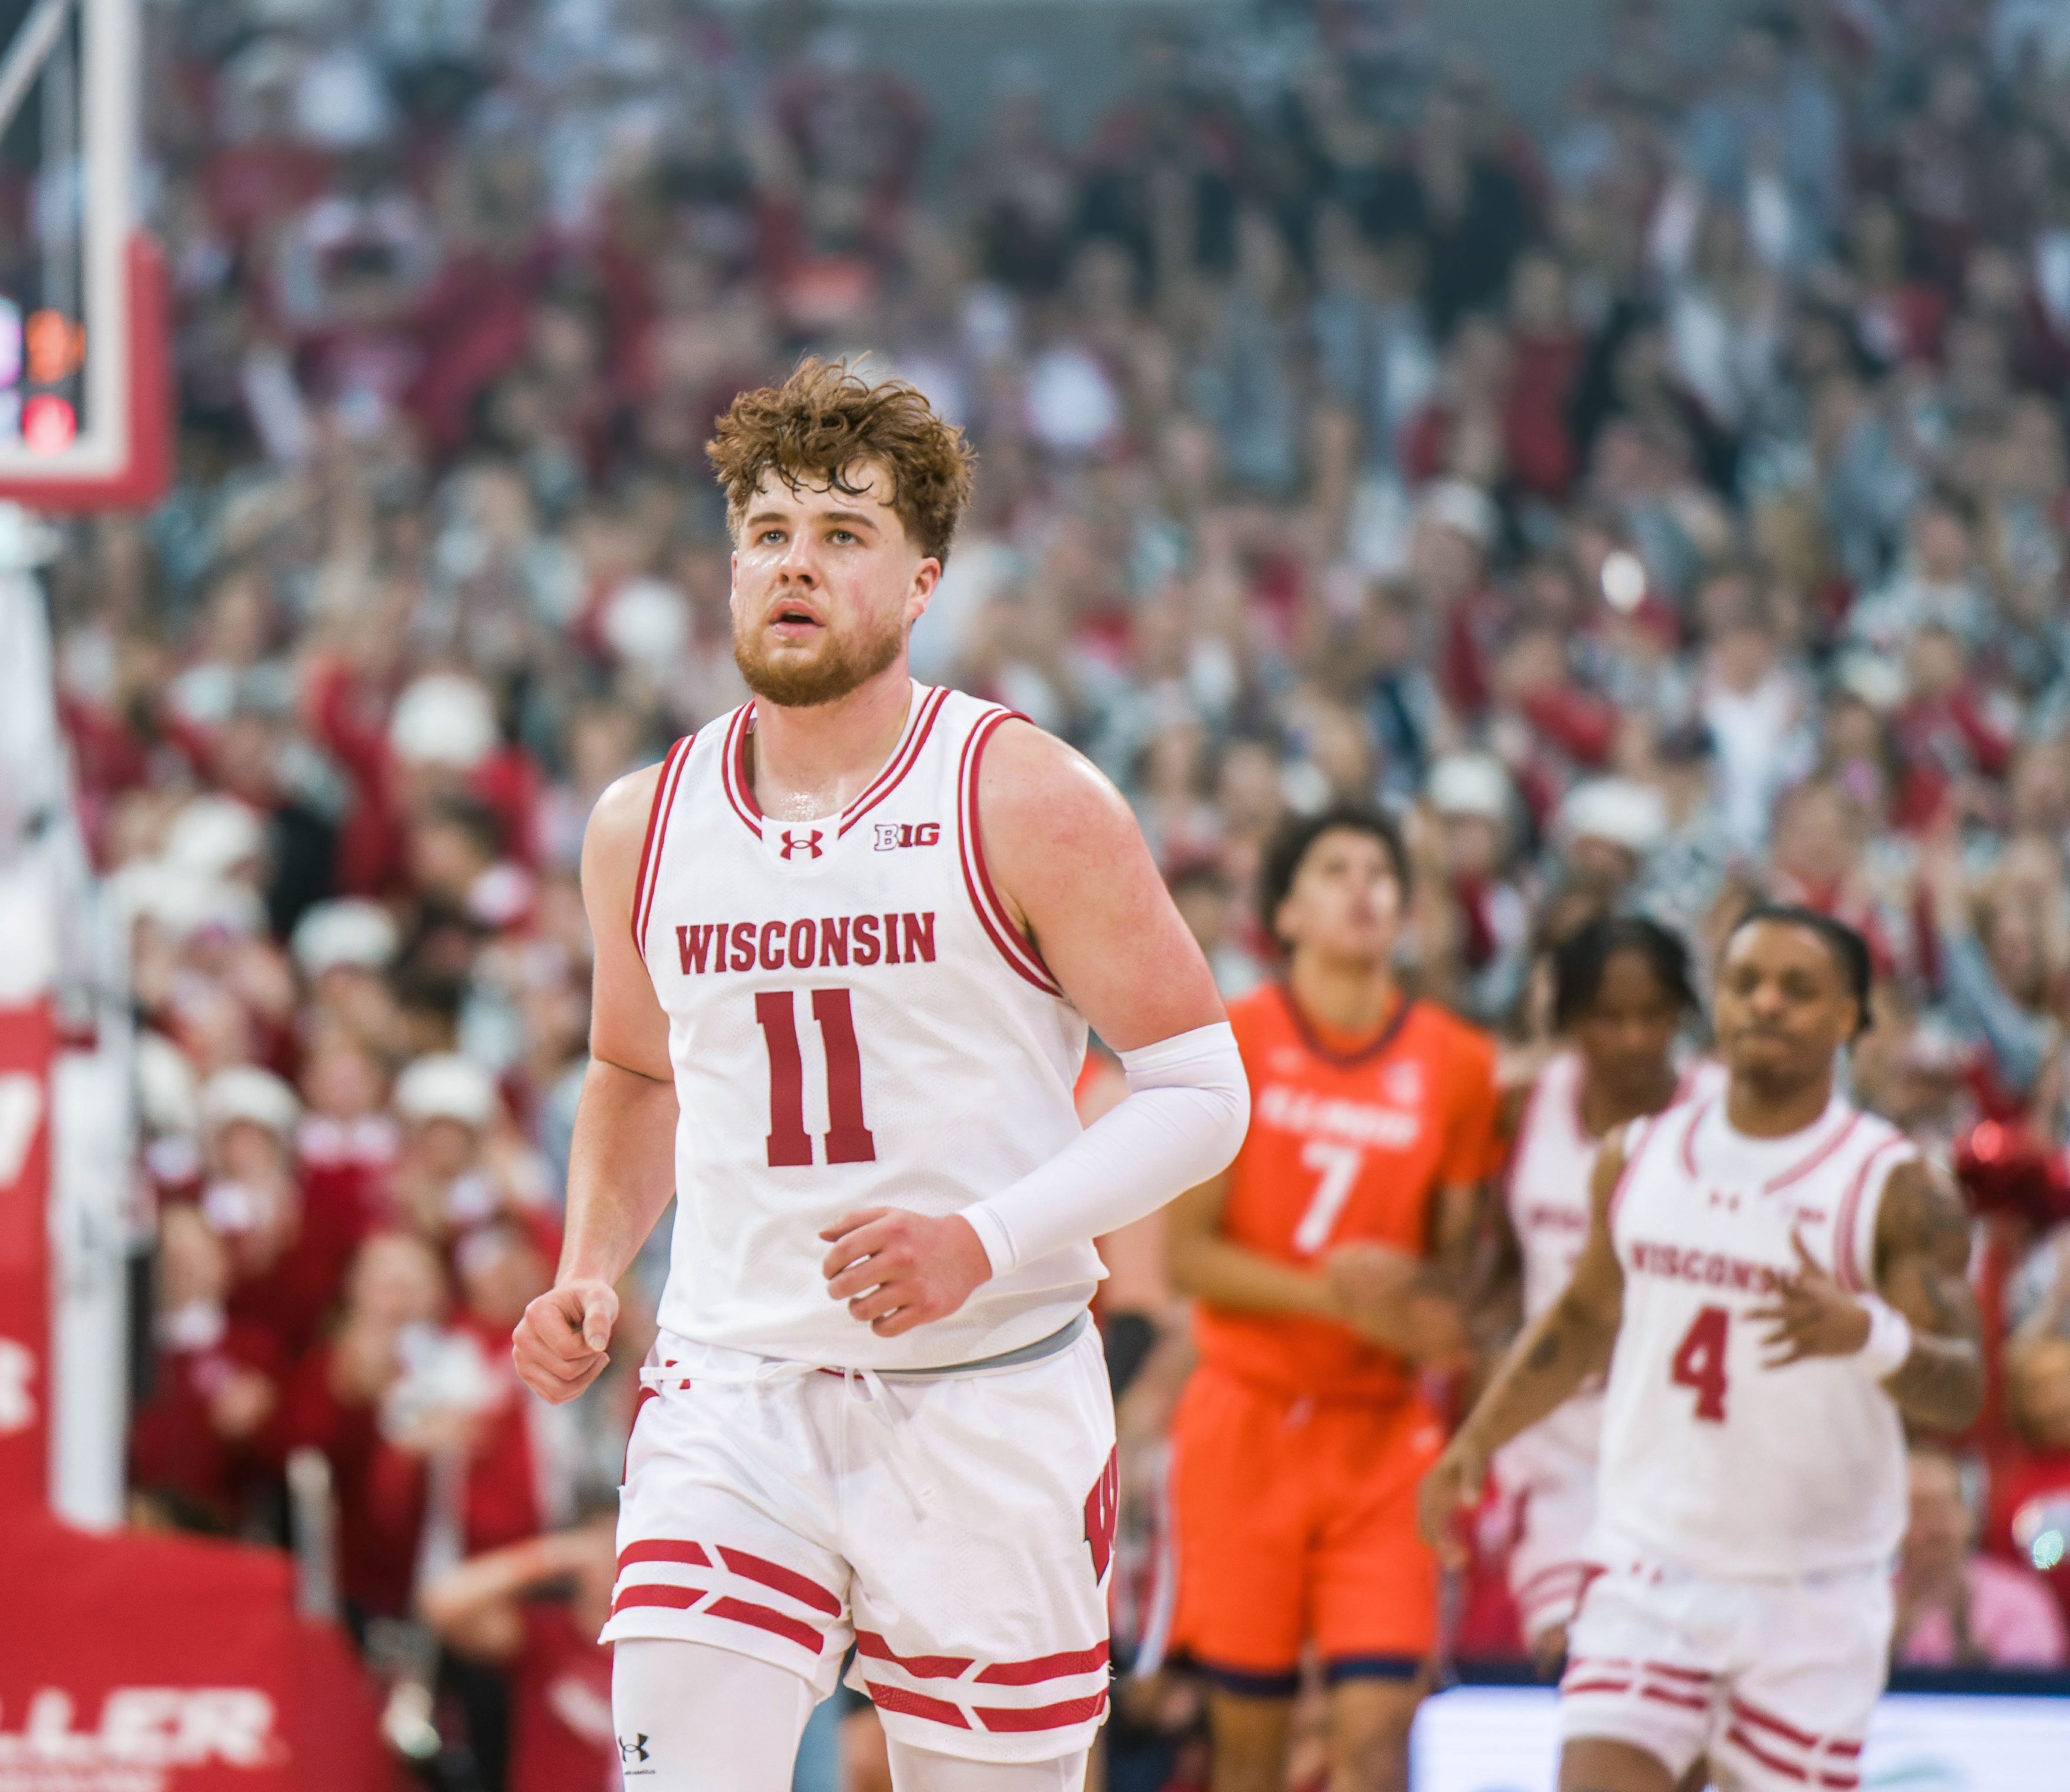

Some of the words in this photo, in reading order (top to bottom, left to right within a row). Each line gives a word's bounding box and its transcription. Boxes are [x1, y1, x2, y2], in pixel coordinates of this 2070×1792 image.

[675, 911, 936, 975] WISCONSIN
[754, 988, 876, 1167] 11
[1297, 1141, 1361, 1253] 7
[1628, 1239, 1795, 1295] WISCON
[1672, 1306, 1729, 1424] 4
